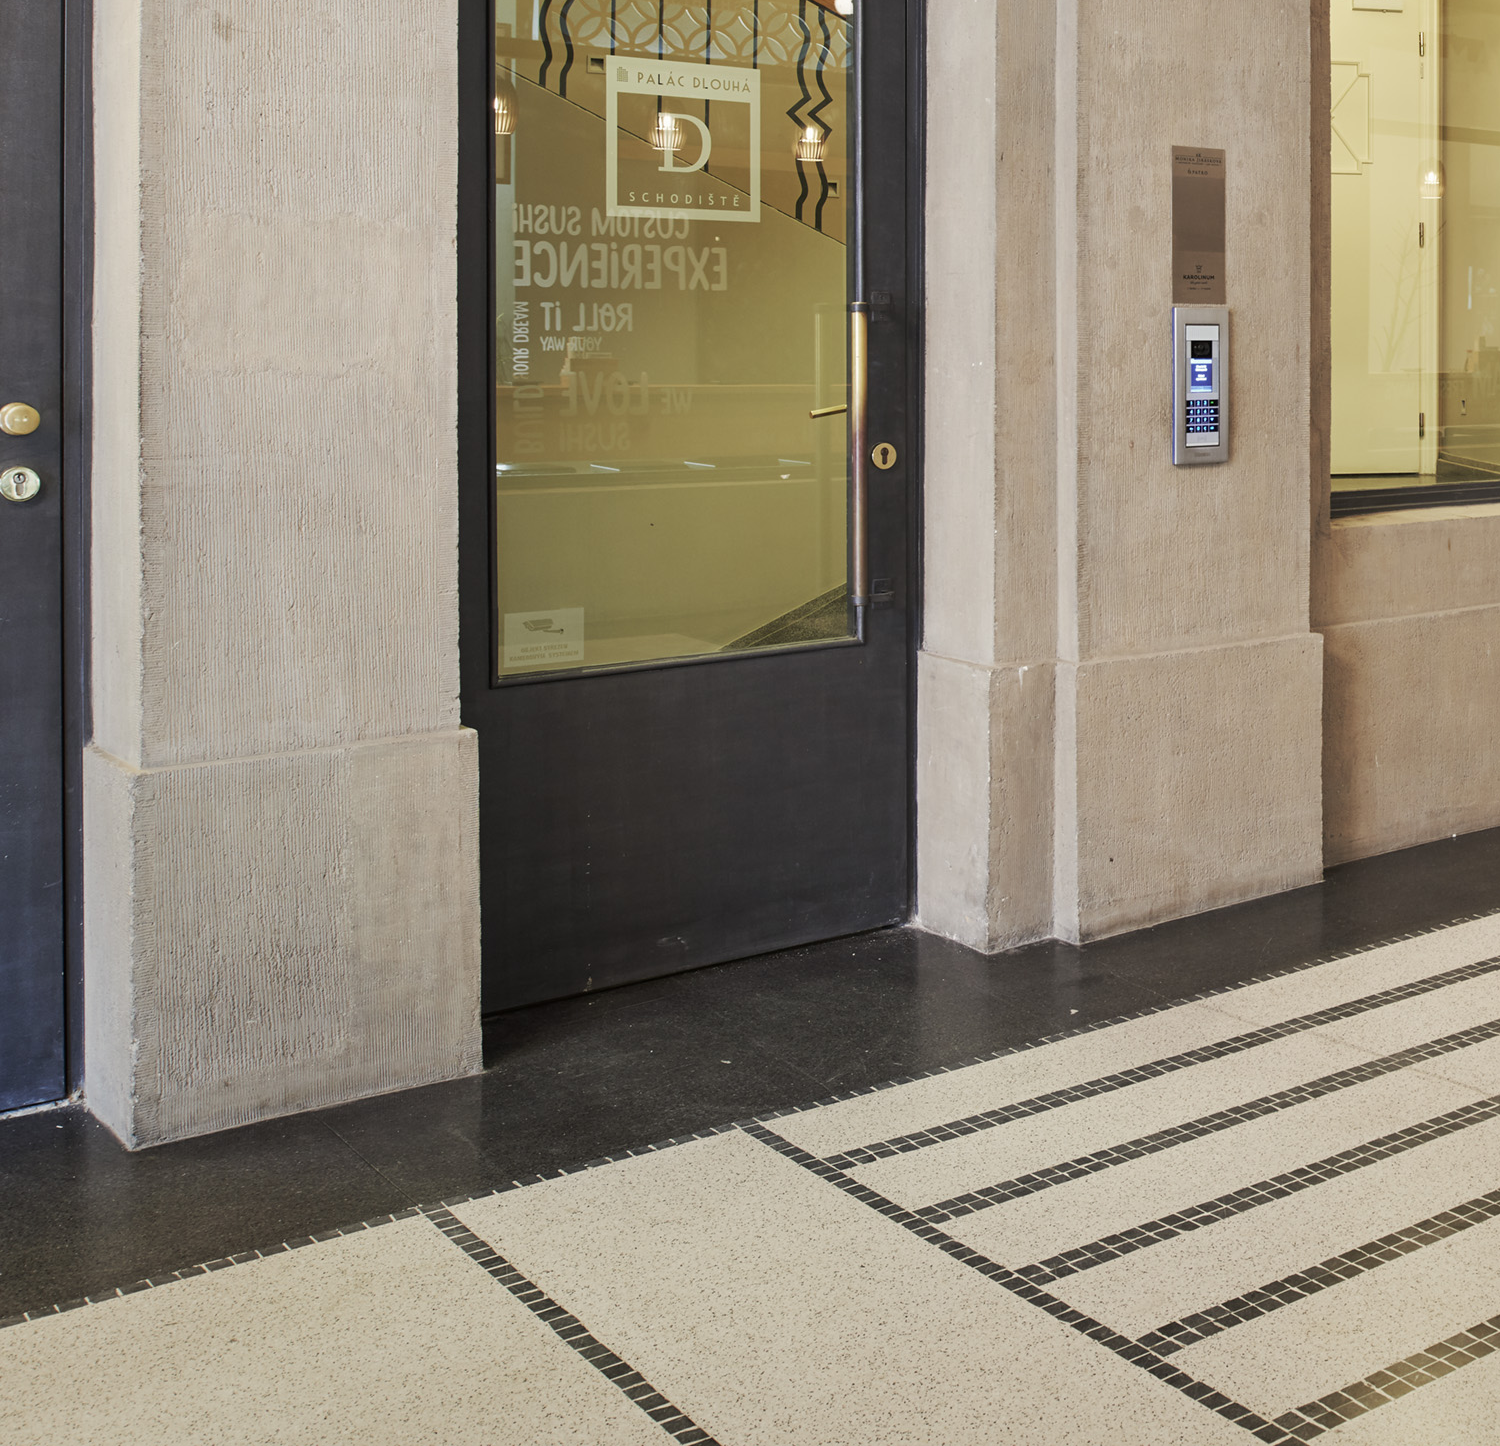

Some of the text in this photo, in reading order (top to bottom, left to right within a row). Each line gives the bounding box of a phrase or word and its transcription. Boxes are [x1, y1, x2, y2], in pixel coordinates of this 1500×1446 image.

[638, 71, 751, 93] PALÁC DLOUHÁ
[658, 112, 712, 173] D
[629, 192, 740, 207] SCHODIŠTĚ
